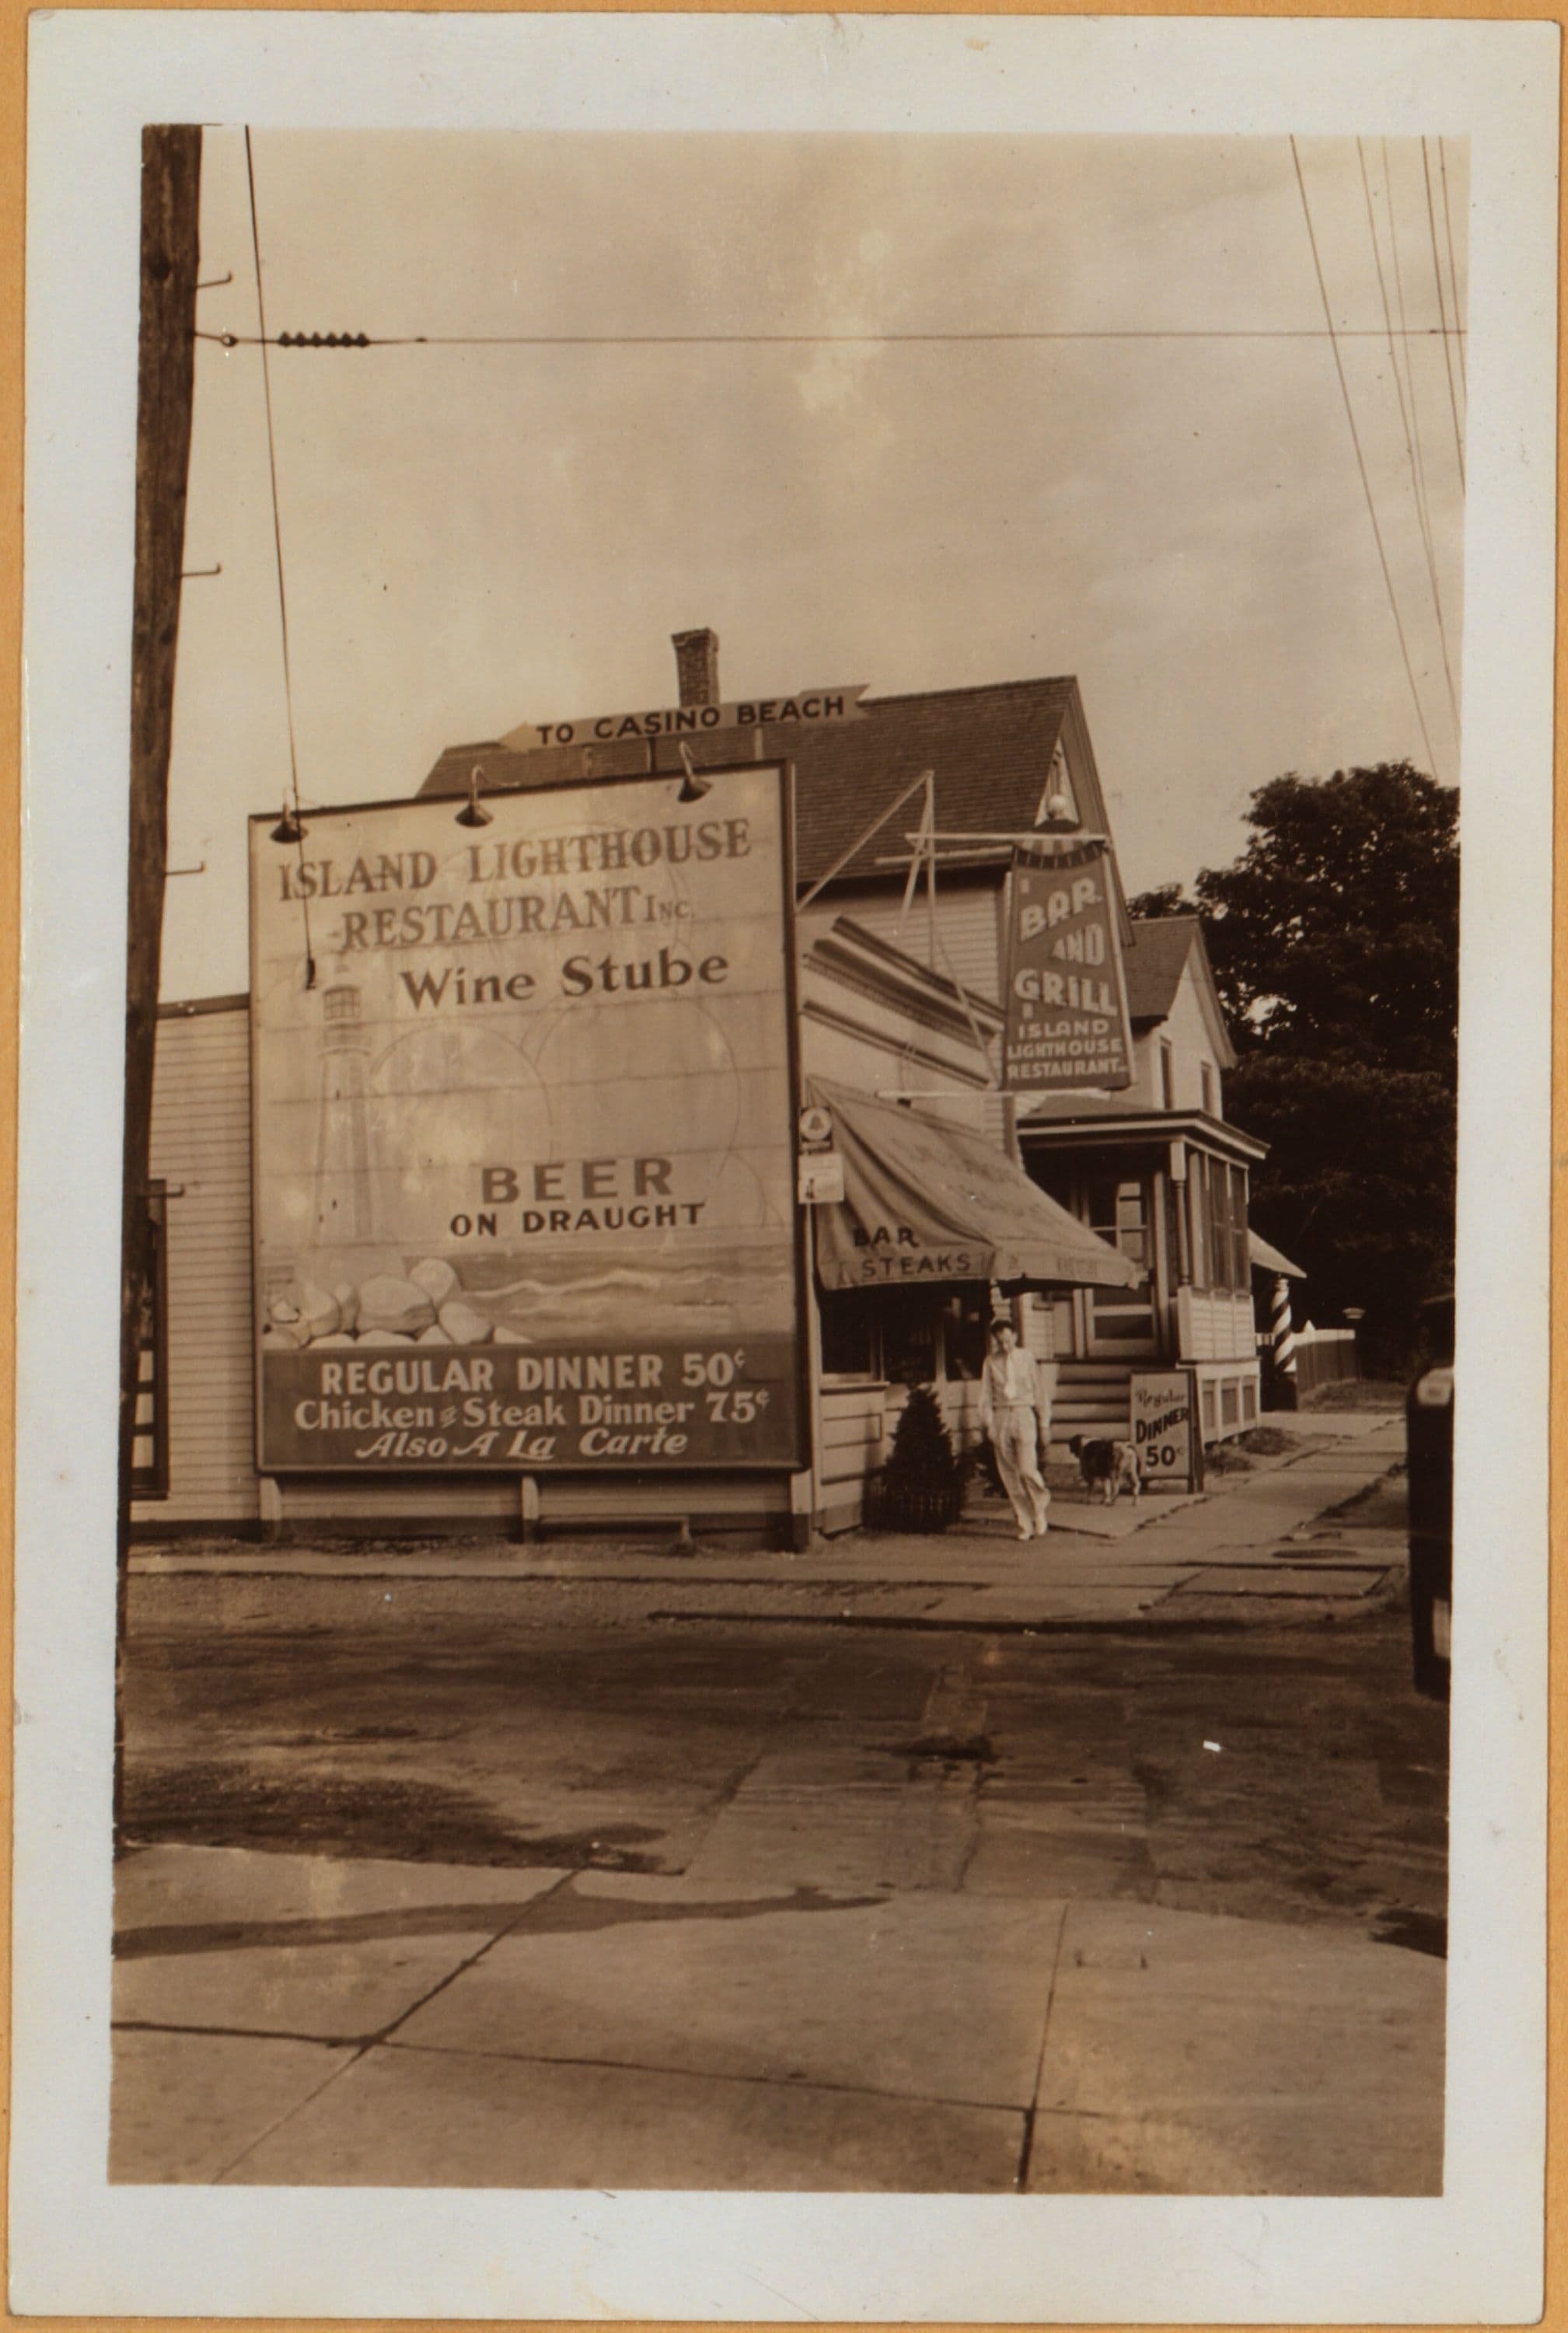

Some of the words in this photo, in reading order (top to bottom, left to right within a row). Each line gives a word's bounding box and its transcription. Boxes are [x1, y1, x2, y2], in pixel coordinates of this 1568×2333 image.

[536, 724, 574, 746] TO
[594, 707, 721, 739] CASINO
[736, 696, 844, 726] BEACH
[278, 851, 437, 901] ISLAND
[470, 818, 753, 882] LIGHTHOUSE
[340, 886, 641, 953] RESTAURANT
[1021, 878, 1103, 942] BAR
[1050, 923, 1105, 966] AND
[400, 967, 536, 1011] Wine
[561, 948, 729, 998] Stube
[1014, 969, 1118, 1017] GRILL
[1007, 1038, 1123, 1060] LIGHTHOUSE
[1018, 1018, 1109, 1040] ISLAND
[1007, 1057, 1119, 1079] RESTAURANT
[482, 1158, 672, 1204] BEER
[449, 1214, 498, 1237] ON
[522, 1202, 706, 1235] DRAUGHT
[853, 1226, 920, 1249] BAR
[862, 1252, 972, 1277] STEAKS
[321, 1359, 494, 1395] REGULAR
[518, 1353, 663, 1391] DINNER
[683, 1348, 746, 1388] 50¢
[295, 1400, 435, 1430] Chicken
[463, 1397, 566, 1427] Steak
[579, 1395, 696, 1425] Dinner
[705, 1391, 771, 1424] 75¢
[1135, 1407, 1189, 1444] DINNER
[355, 1432, 448, 1459] Also
[452, 1430, 499, 1458] A
[506, 1431, 556, 1461] La
[578, 1427, 689, 1457] Carte
